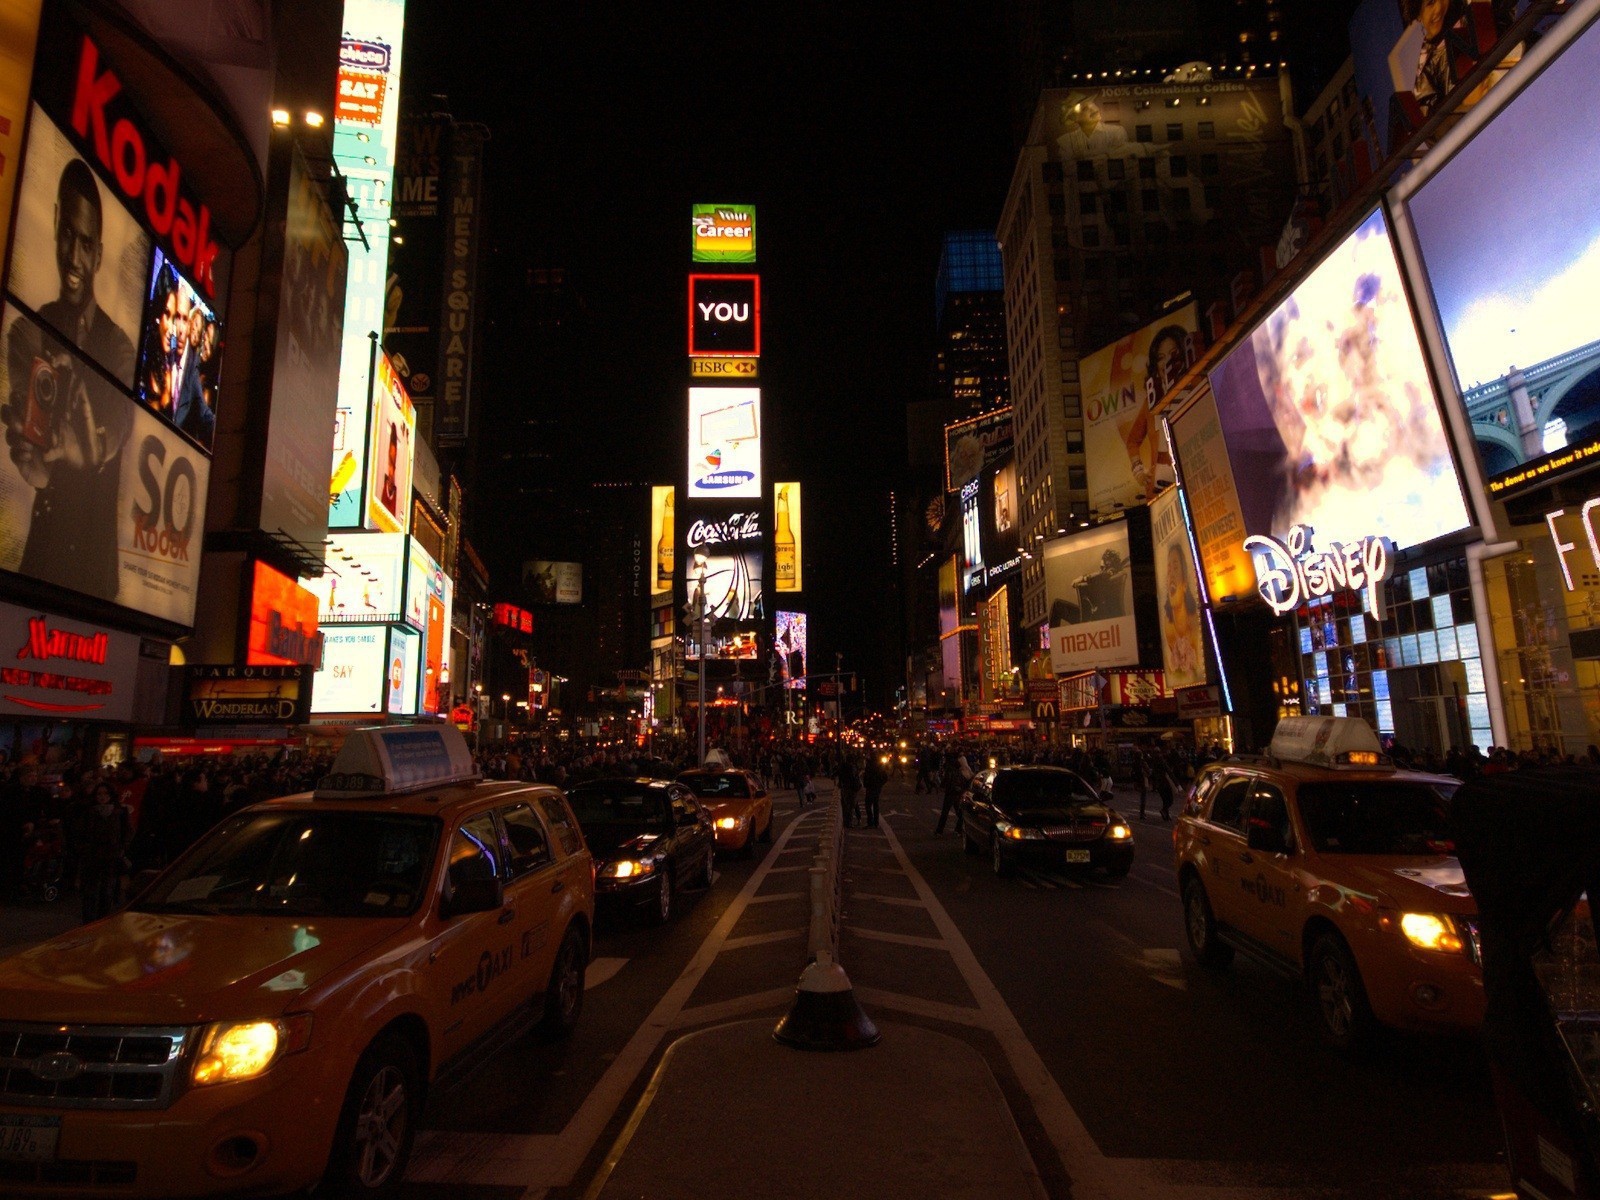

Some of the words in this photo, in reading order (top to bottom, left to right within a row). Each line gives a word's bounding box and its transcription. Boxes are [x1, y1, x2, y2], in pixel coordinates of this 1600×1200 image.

[1101, 86, 1130, 97] 100%
[1133, 83, 1200, 96] Colombian
[1203, 82, 1246, 93] Coffee
[71, 33, 220, 300] Kodak
[453, 155, 475, 258] TIMES
[696, 224, 752, 238] Career
[698, 303, 749, 322] YOU
[444, 269, 470, 403] SQUARE
[692, 362, 734, 373] HSBC
[1086, 382, 1136, 422] OWN
[1490, 480, 1504, 492] The
[1536, 463, 1550, 474] we
[1550, 453, 1574, 470] know
[1574, 449, 1582, 460] it
[132, 434, 197, 541] SO
[633, 538, 641, 597] NOVOTEL
[982, 608, 993, 680] PALACE
[1060, 623, 1121, 655] maxell
[1, 667, 32, 687] NEW
[33, 671, 66, 691] YORK
[193, 667, 302, 678] MARQUIS
[333, 665, 354, 679] SAY
[192, 700, 296, 720] WONDERLAND
